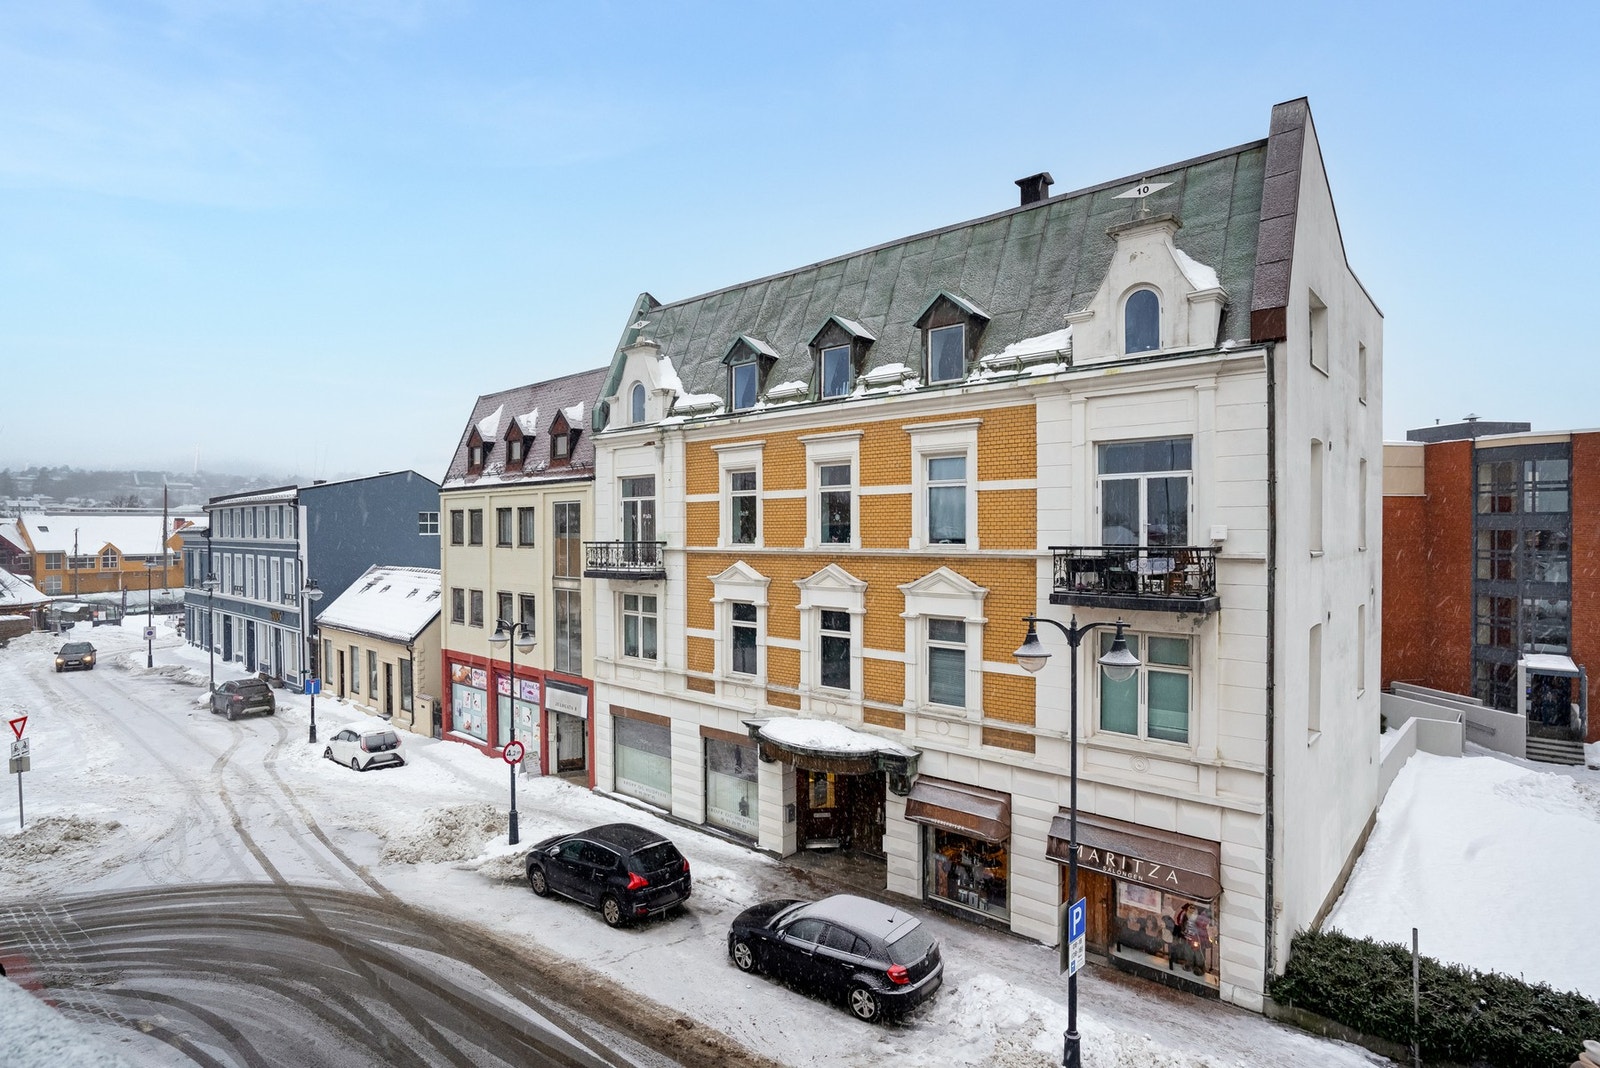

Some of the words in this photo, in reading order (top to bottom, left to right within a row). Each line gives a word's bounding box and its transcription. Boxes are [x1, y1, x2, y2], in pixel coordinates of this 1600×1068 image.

[1137, 186, 1149, 195] 10
[1102, 865, 1144, 881] SALONGEN
[1073, 906, 1082, 936] P
